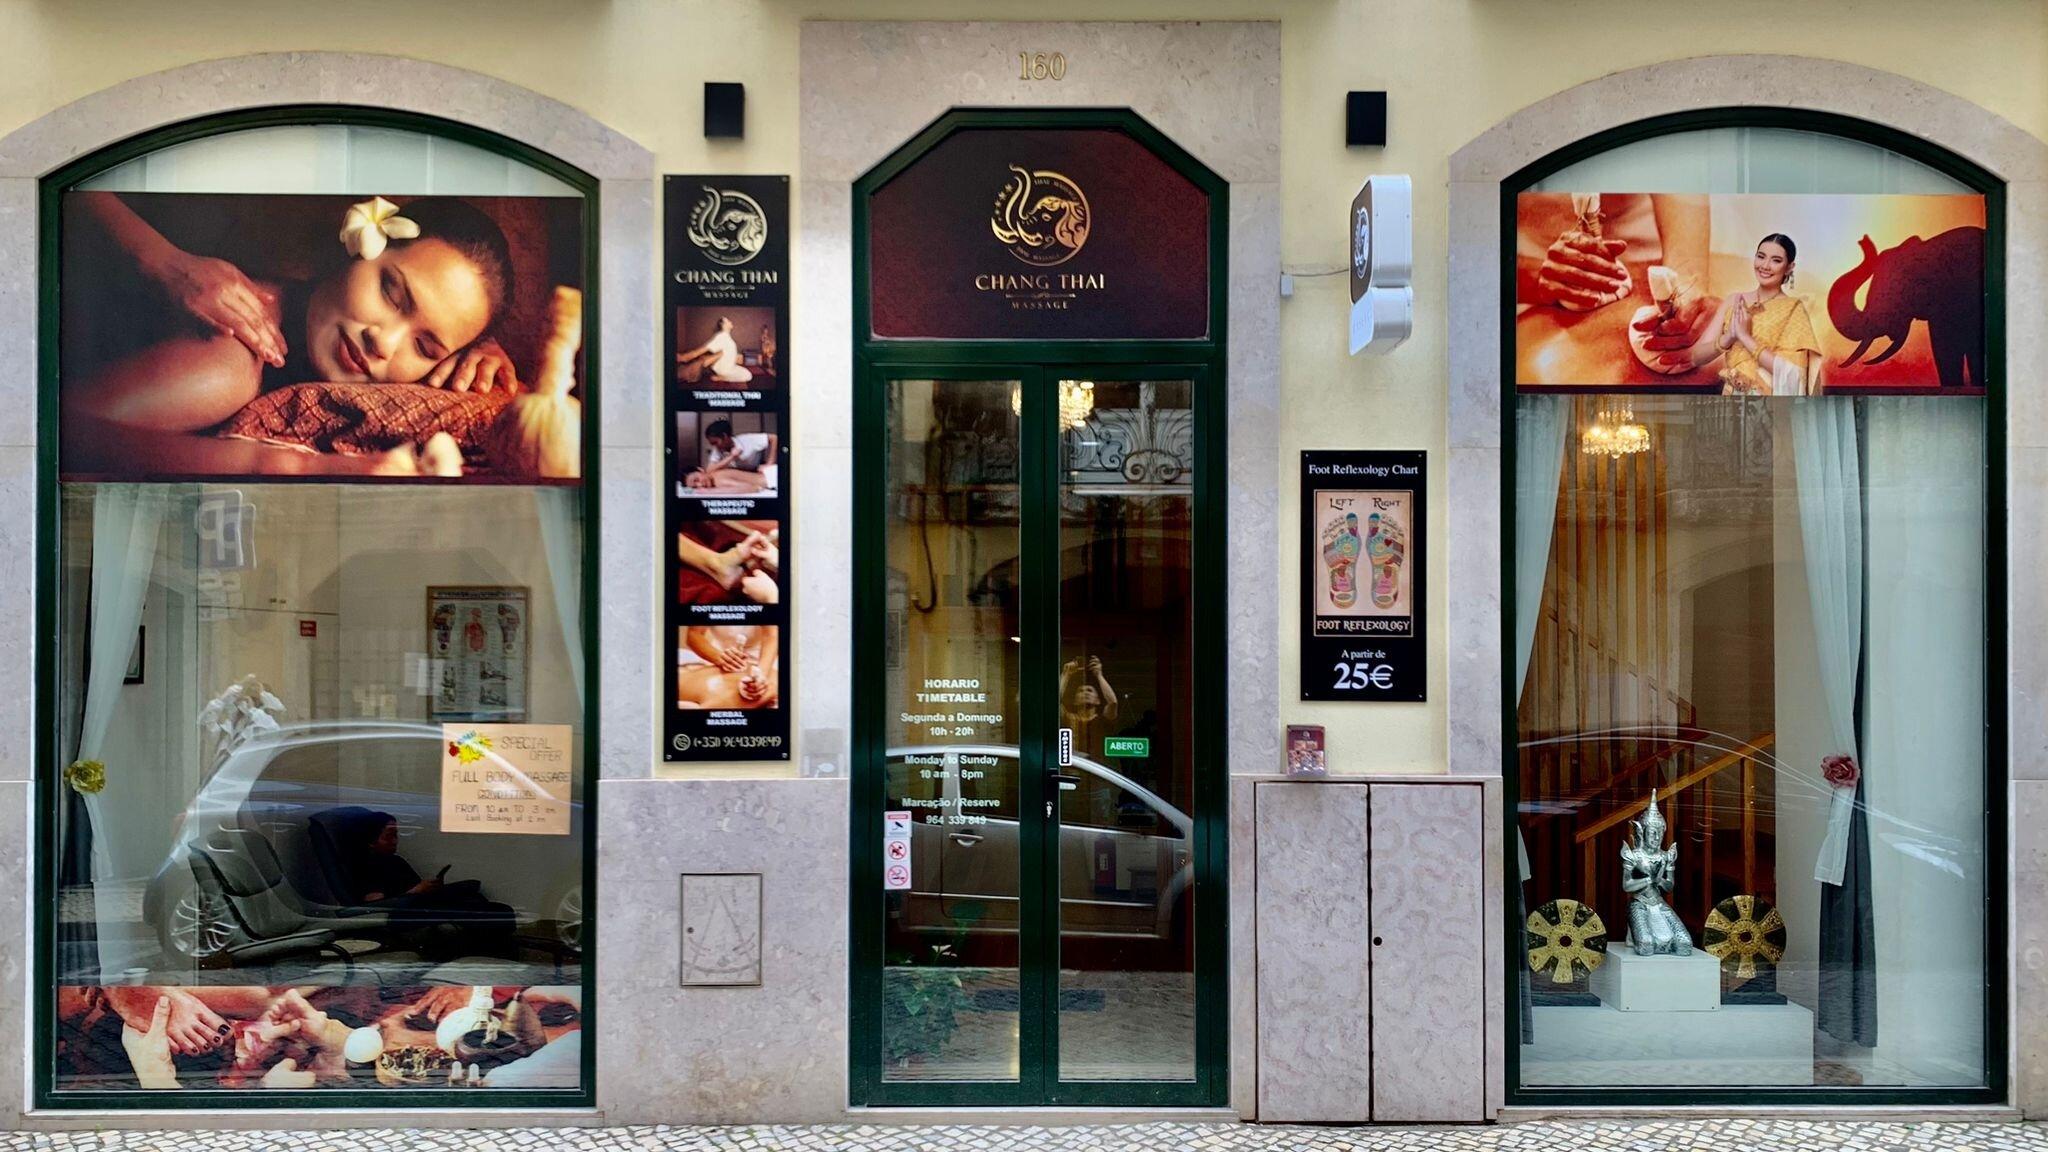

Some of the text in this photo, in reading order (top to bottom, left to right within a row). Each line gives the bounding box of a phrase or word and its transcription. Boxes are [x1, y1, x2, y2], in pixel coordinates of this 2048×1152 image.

[1018, 51, 1067, 81] 160
[674, 270, 778, 284] CHANG THAI
[974, 273, 1105, 291] CHANG THAI
[703, 291, 749, 299] MASSAGE
[1011, 300, 1069, 310] MASSAGE
[693, 391, 761, 400] TRADITIONAL THAI
[1309, 464, 1418, 476] Foot Reflexology Chart
[708, 507, 747, 515] MASSAGE
[713, 605, 763, 613] REFLEXOLOGY
[1316, 620, 1410, 632] FOOT REFLEXOLOGY
[1341, 650, 1386, 661] A partir de
[1333, 662, 1394, 690] 25€
[924, 679, 979, 688] HORARIO
[916, 693, 986, 702] TIMETABLE
[706, 718, 748, 726] MASSAGE
[900, 713, 946, 724] Segunda
[957, 713, 1003, 725] Domingo
[930, 727, 947, 736] 10h
[955, 727, 974, 736] 20h
[500, 736, 553, 750] SPECIAL
[1110, 742, 1144, 750] ABERTO
[529, 750, 563, 761] OFFER
[905, 755, 998, 766] Monday to Sunday
[452, 770, 479, 783] FULL
[486, 770, 513, 783] BODY
[920, 769, 932, 779] 10
[933, 771, 950, 779] am
[961, 769, 983, 780] 8pm
[902, 798, 950, 809] Marcação
[960, 798, 1000, 807] Reserve
[926, 815, 944, 825] 964
[948, 815, 965, 825] 339
